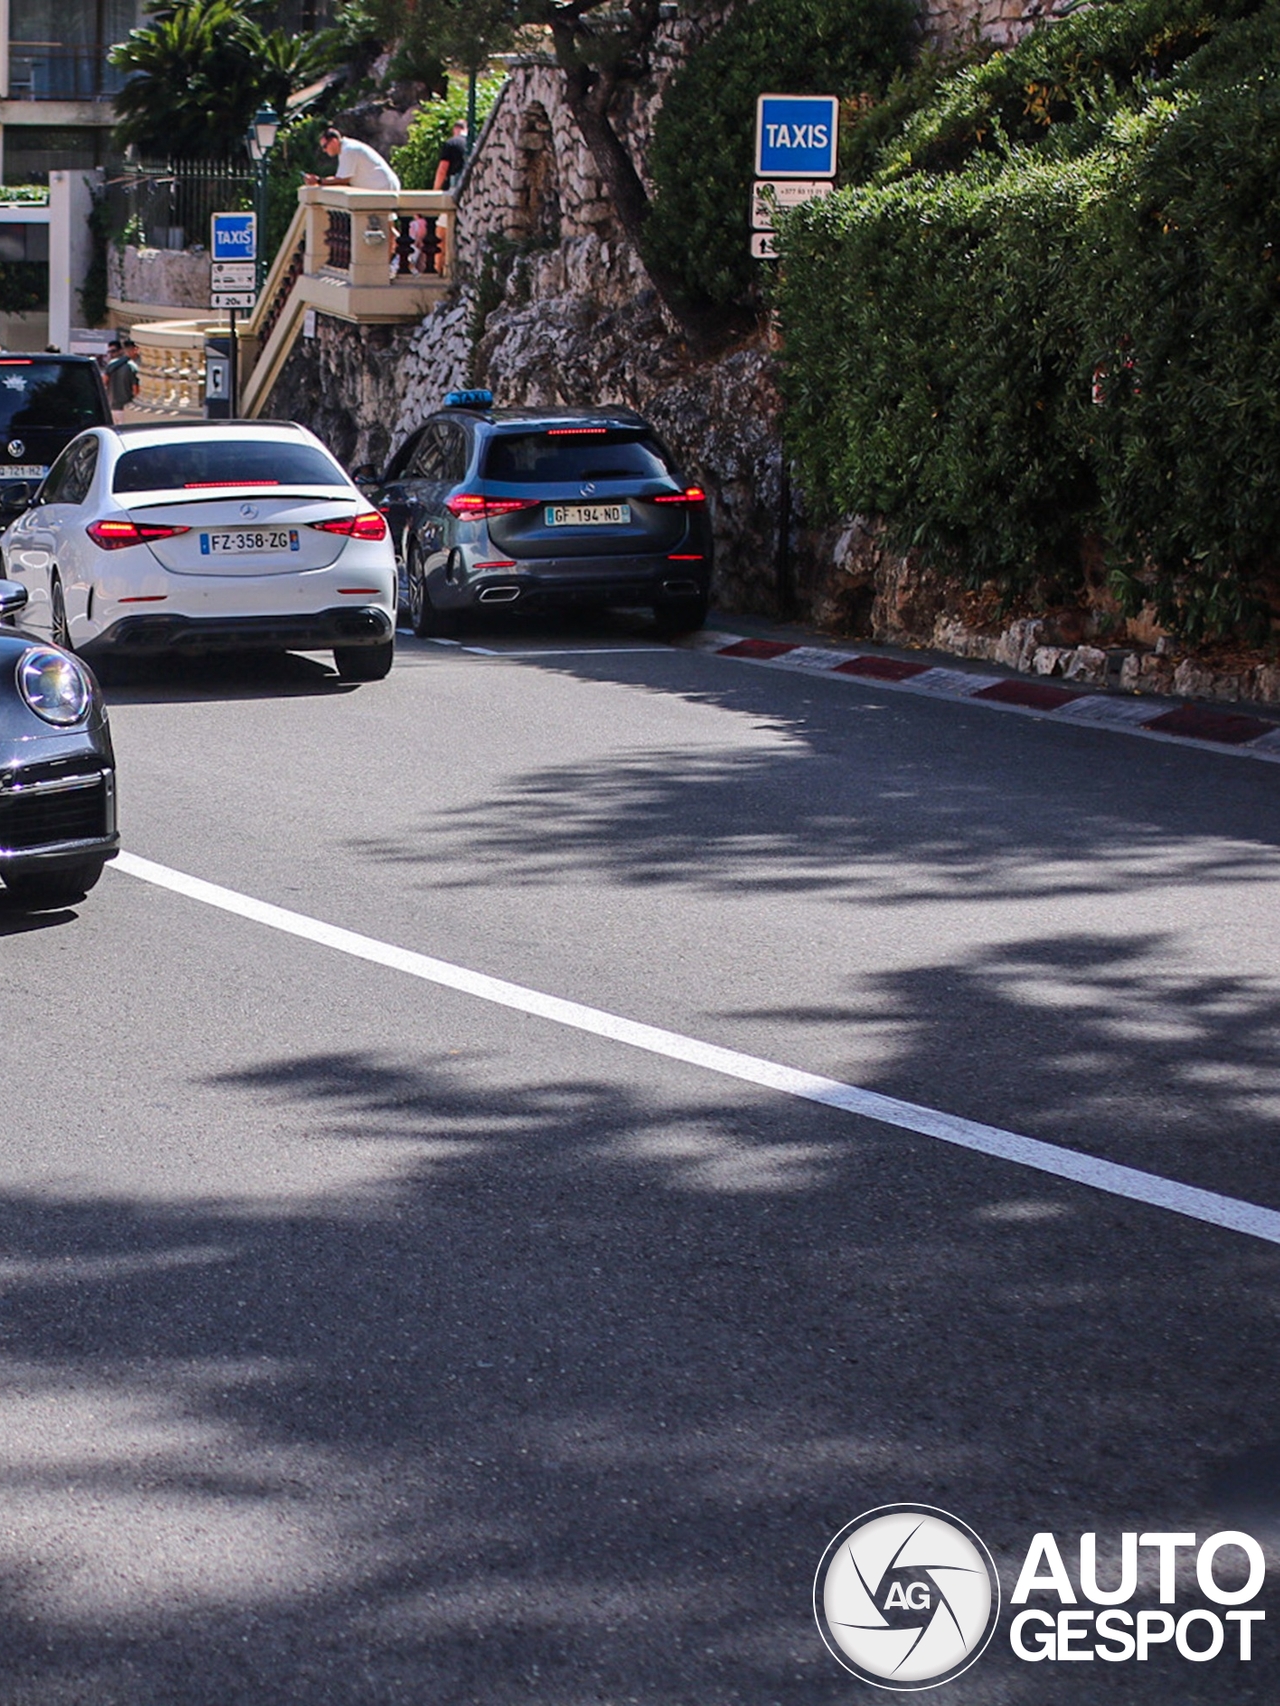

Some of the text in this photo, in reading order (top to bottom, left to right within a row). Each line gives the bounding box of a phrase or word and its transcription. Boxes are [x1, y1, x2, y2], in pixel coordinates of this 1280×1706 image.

[765, 124, 828, 148] TAXIS
[216, 230, 251, 245] TAXIS
[211, 533, 288, 551] FZ-358-ZG
